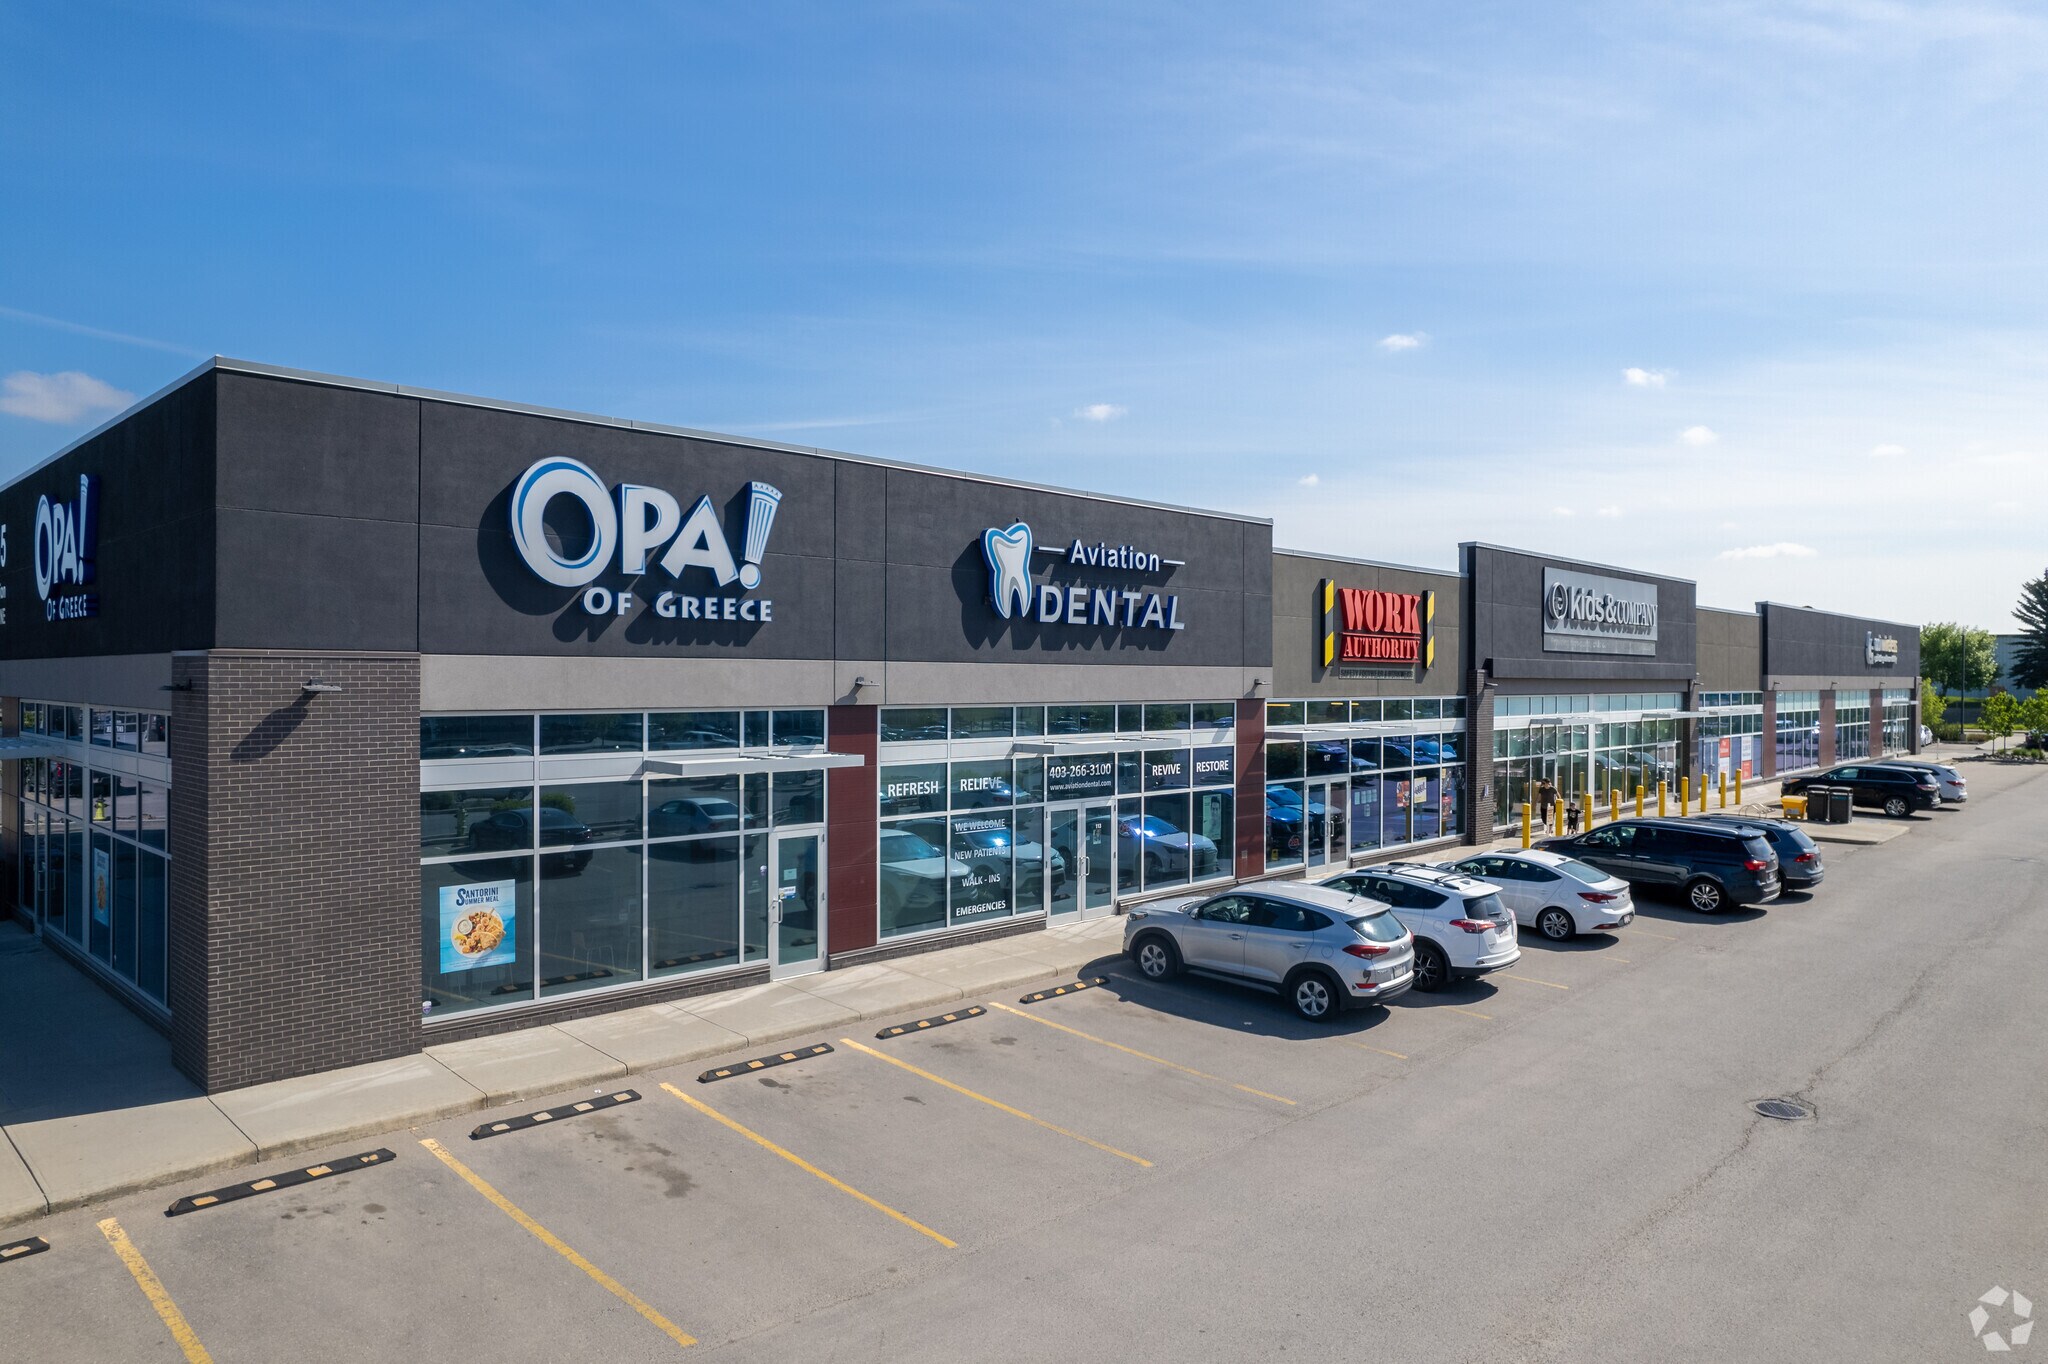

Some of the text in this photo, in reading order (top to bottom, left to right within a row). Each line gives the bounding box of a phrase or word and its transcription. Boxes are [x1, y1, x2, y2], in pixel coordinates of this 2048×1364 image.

[510, 456, 783, 590] OPA!
[35, 473, 89, 601] OPA!
[1070, 538, 1160, 572] Aviation
[47, 594, 88, 622] OF GREECE
[583, 587, 773, 622] OF GREECE
[1038, 584, 1185, 630] DENTAL
[1342, 587, 1421, 634] WORK
[1343, 636, 1420, 659] AUTHORITY
[1049, 763, 1112, 779] 403-266-3100
[1152, 763, 1181, 776] REVIVE
[1196, 760, 1229, 773] RESTORE
[887, 780, 939, 798] REFRESH
[960, 776, 1003, 791] RELIEVE
[1049, 780, 1112, 791] www.aviationdental.com
[954, 818, 1007, 832] WE WELCOME
[954, 846, 1006, 861] NEW PATIENTS
[962, 875, 983, 888] WALK
[988, 873, 1001, 884] INS
[456, 887, 499, 906] SANTORINI
[956, 899, 1006, 917] EMERGENCIES
